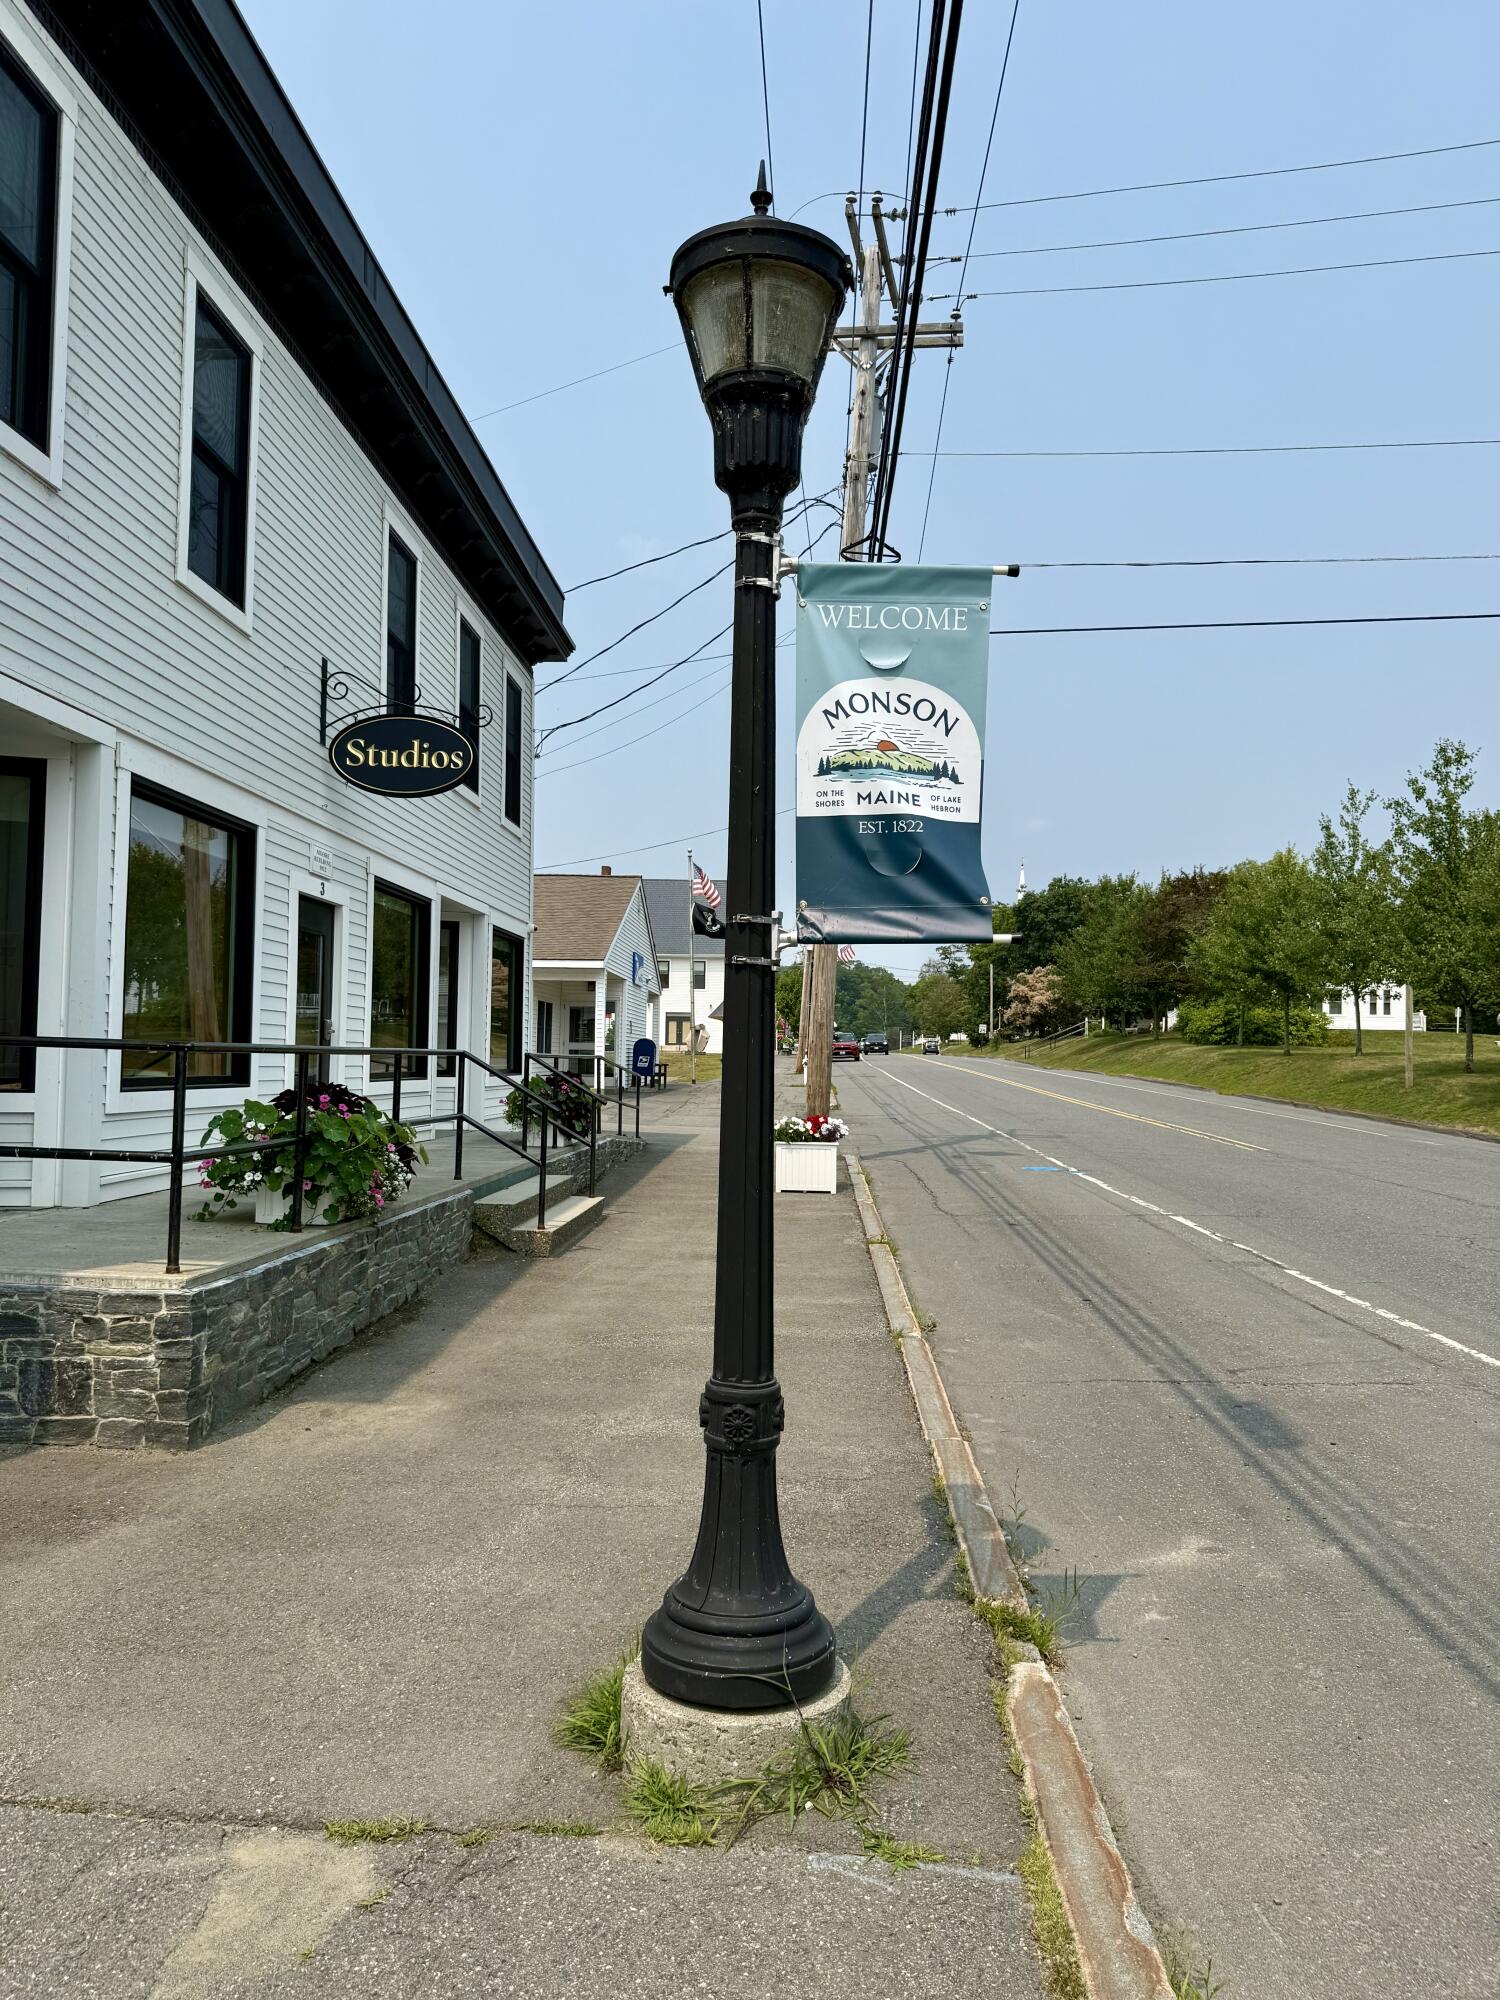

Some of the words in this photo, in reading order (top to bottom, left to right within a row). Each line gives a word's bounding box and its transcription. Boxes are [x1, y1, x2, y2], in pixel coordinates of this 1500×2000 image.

[817, 604, 968, 631] WELCOME
[822, 691, 960, 738] MONSON
[346, 738, 464, 770] Studios
[815, 800, 845, 808] SHORES
[857, 790, 922, 807] MAINE
[943, 796, 961, 804] LAKE
[931, 805, 961, 813] HEBRON
[858, 820, 889, 834] EST.
[893, 819, 924, 833] 1822
[320, 882, 325, 896] 3
